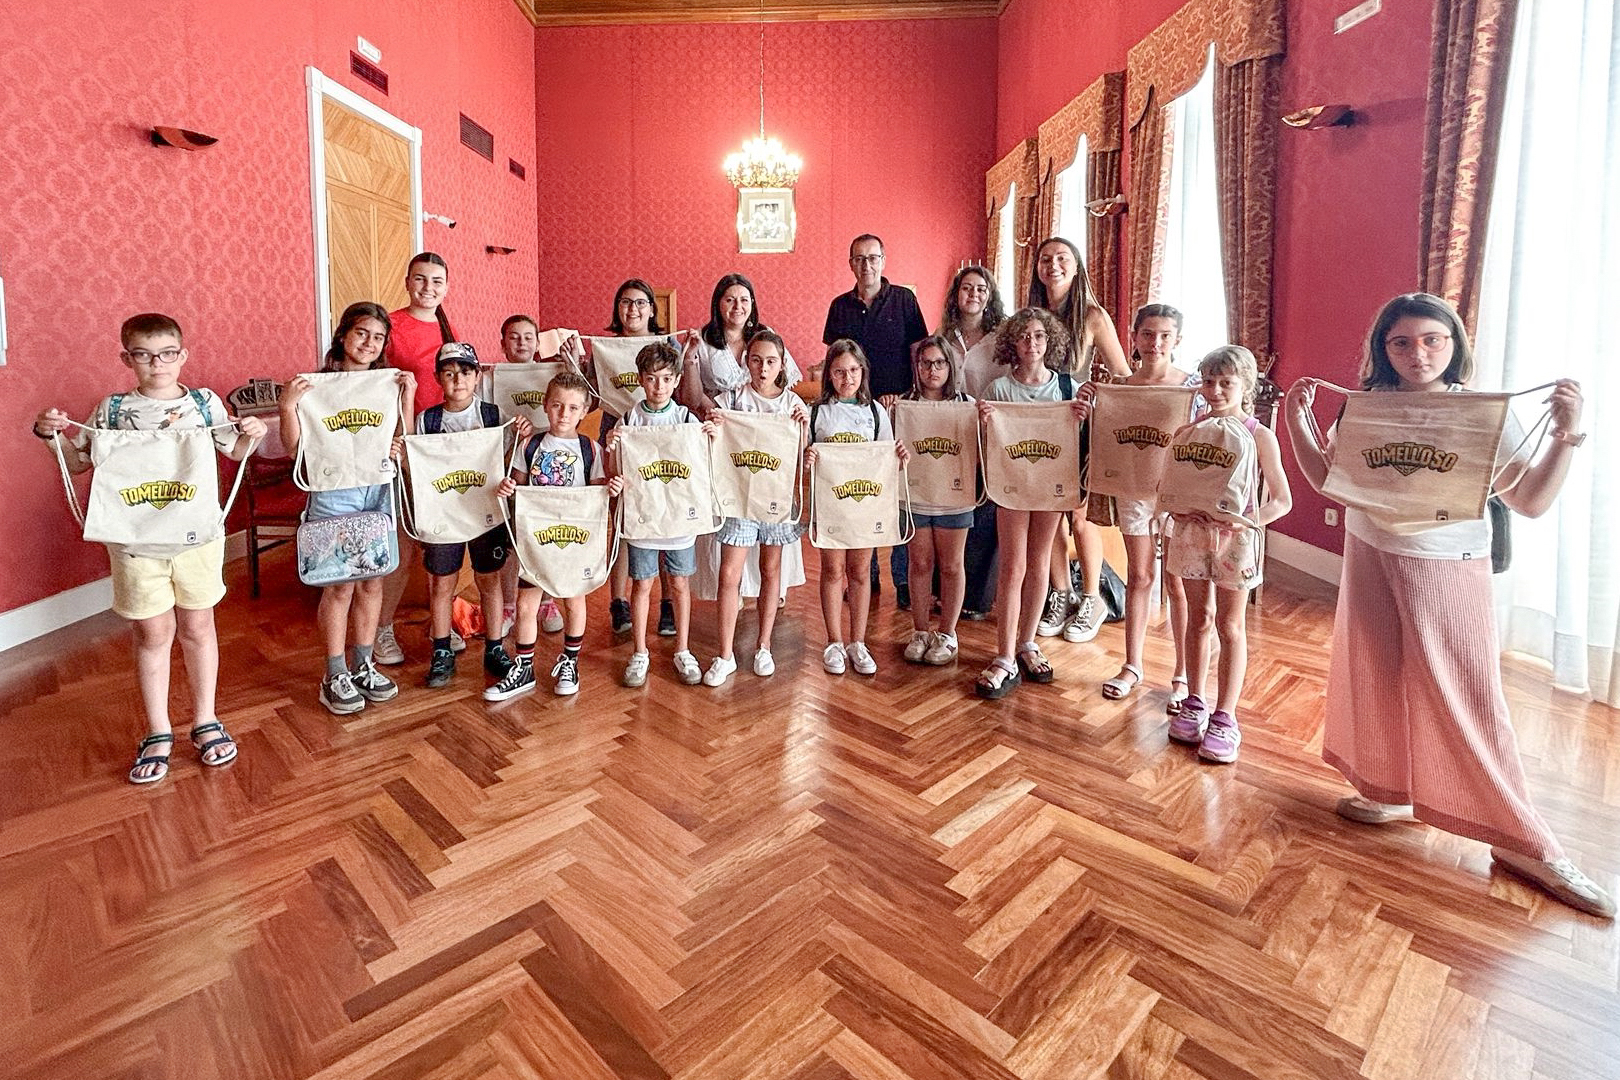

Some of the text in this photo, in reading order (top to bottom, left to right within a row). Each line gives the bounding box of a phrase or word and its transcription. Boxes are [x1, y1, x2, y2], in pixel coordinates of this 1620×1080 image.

[610, 373, 639, 389] TOMELL
[322, 410, 383, 431] TOMELLOSO
[912, 438, 962, 456] TOMELLOSO
[1113, 427, 1172, 448] TOMELLOSO
[1005, 440, 1061, 460] TOMELLOSO
[1172, 443, 1235, 468] TOMELLOSO
[1361, 444, 1459, 473] TOMELLOSO
[638, 461, 690, 481] TOMELLOSO
[730, 451, 781, 471] TOMELLOSO
[431, 471, 487, 493] TOMELLOSO
[832, 480, 882, 500] TOMELLOSO
[119, 482, 197, 506] TOMELLOSO
[534, 526, 590, 545] TOMELLOSO
